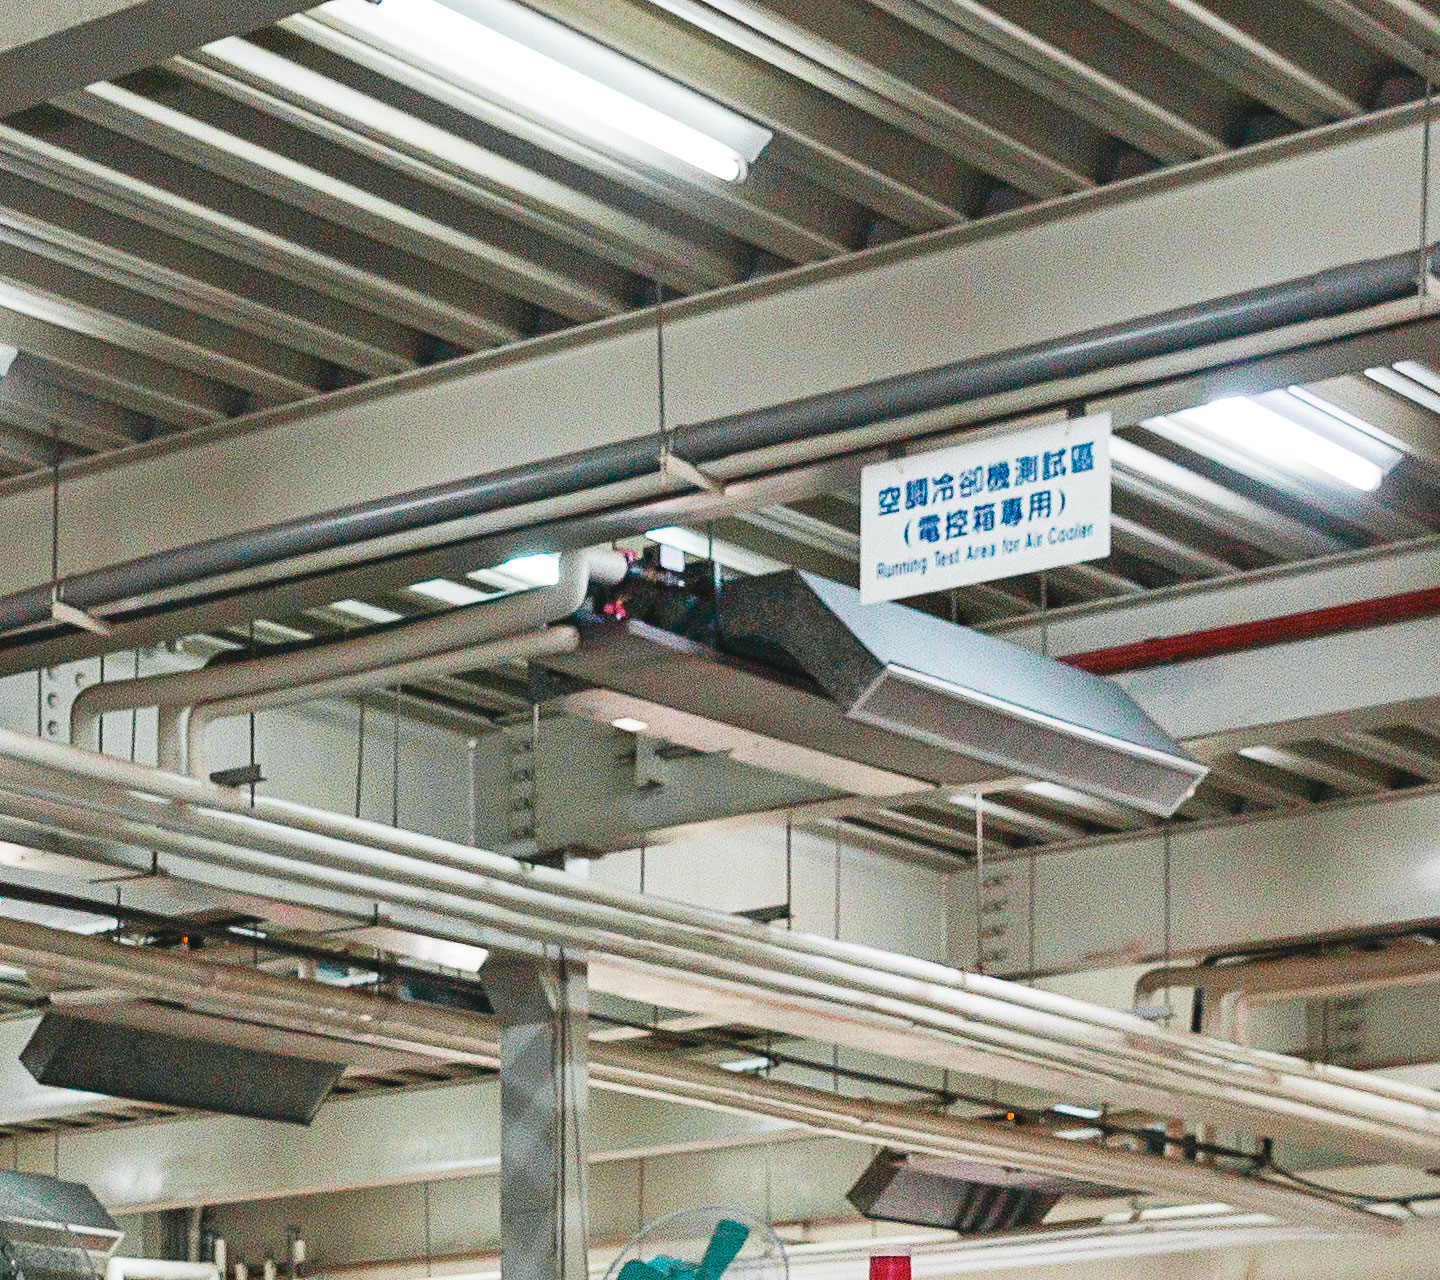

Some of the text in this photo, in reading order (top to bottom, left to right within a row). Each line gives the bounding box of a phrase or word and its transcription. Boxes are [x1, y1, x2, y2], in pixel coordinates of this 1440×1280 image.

[876, 557, 928, 579] Running
[935, 549, 960, 567] Test
[967, 543, 996, 561] Area
[1025, 533, 1043, 549] Air
[1047, 522, 1094, 545] Cooler
